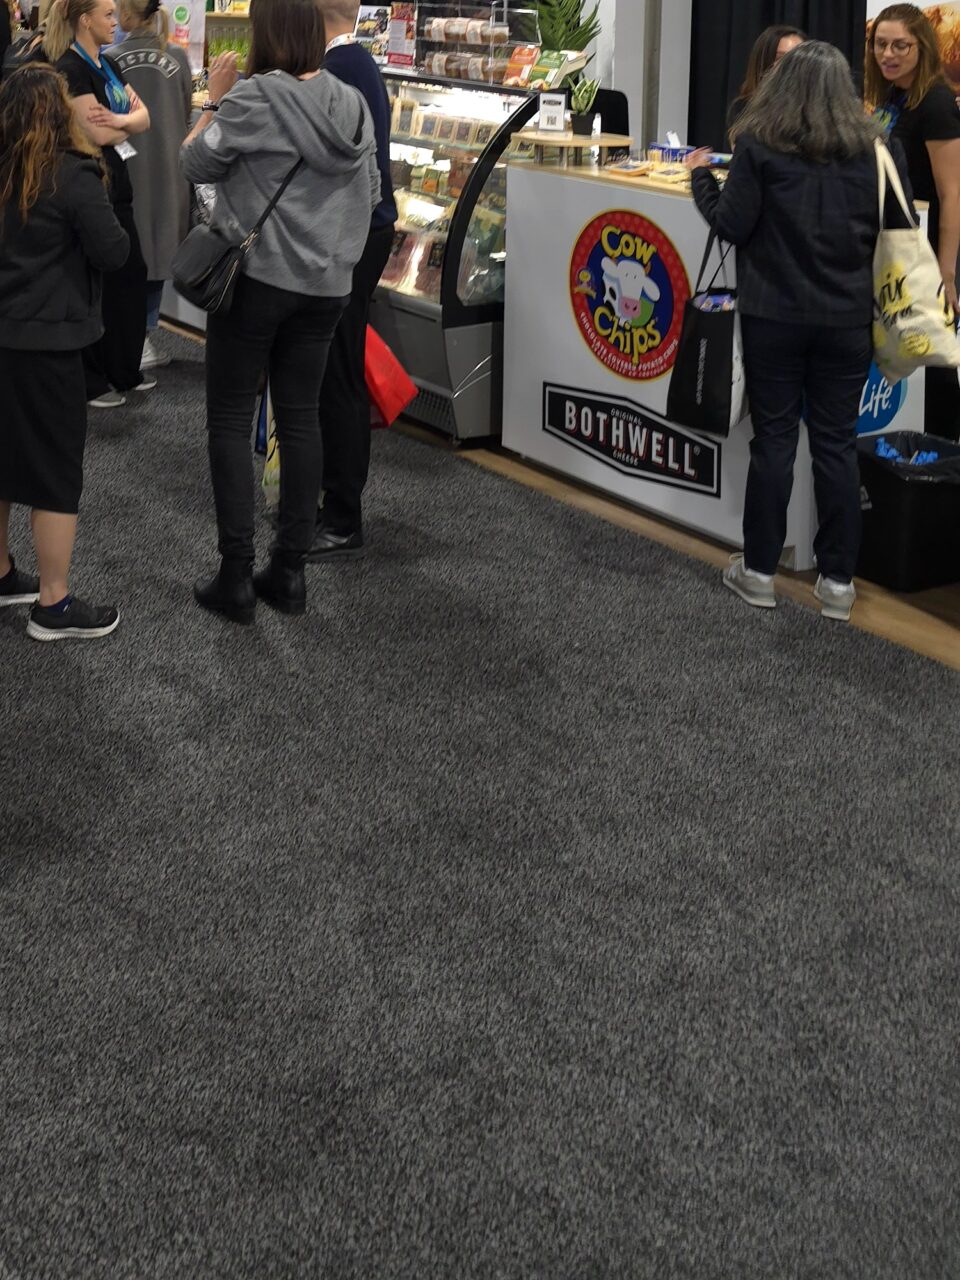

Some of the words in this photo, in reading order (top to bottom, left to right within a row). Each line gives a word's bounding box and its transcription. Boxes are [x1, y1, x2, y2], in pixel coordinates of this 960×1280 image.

[593, 305, 661, 367] Chips
[610, 407, 643, 426] ORIGINAL
[858, 376, 893, 419] Life
[564, 399, 697, 478] BOTHWELL
